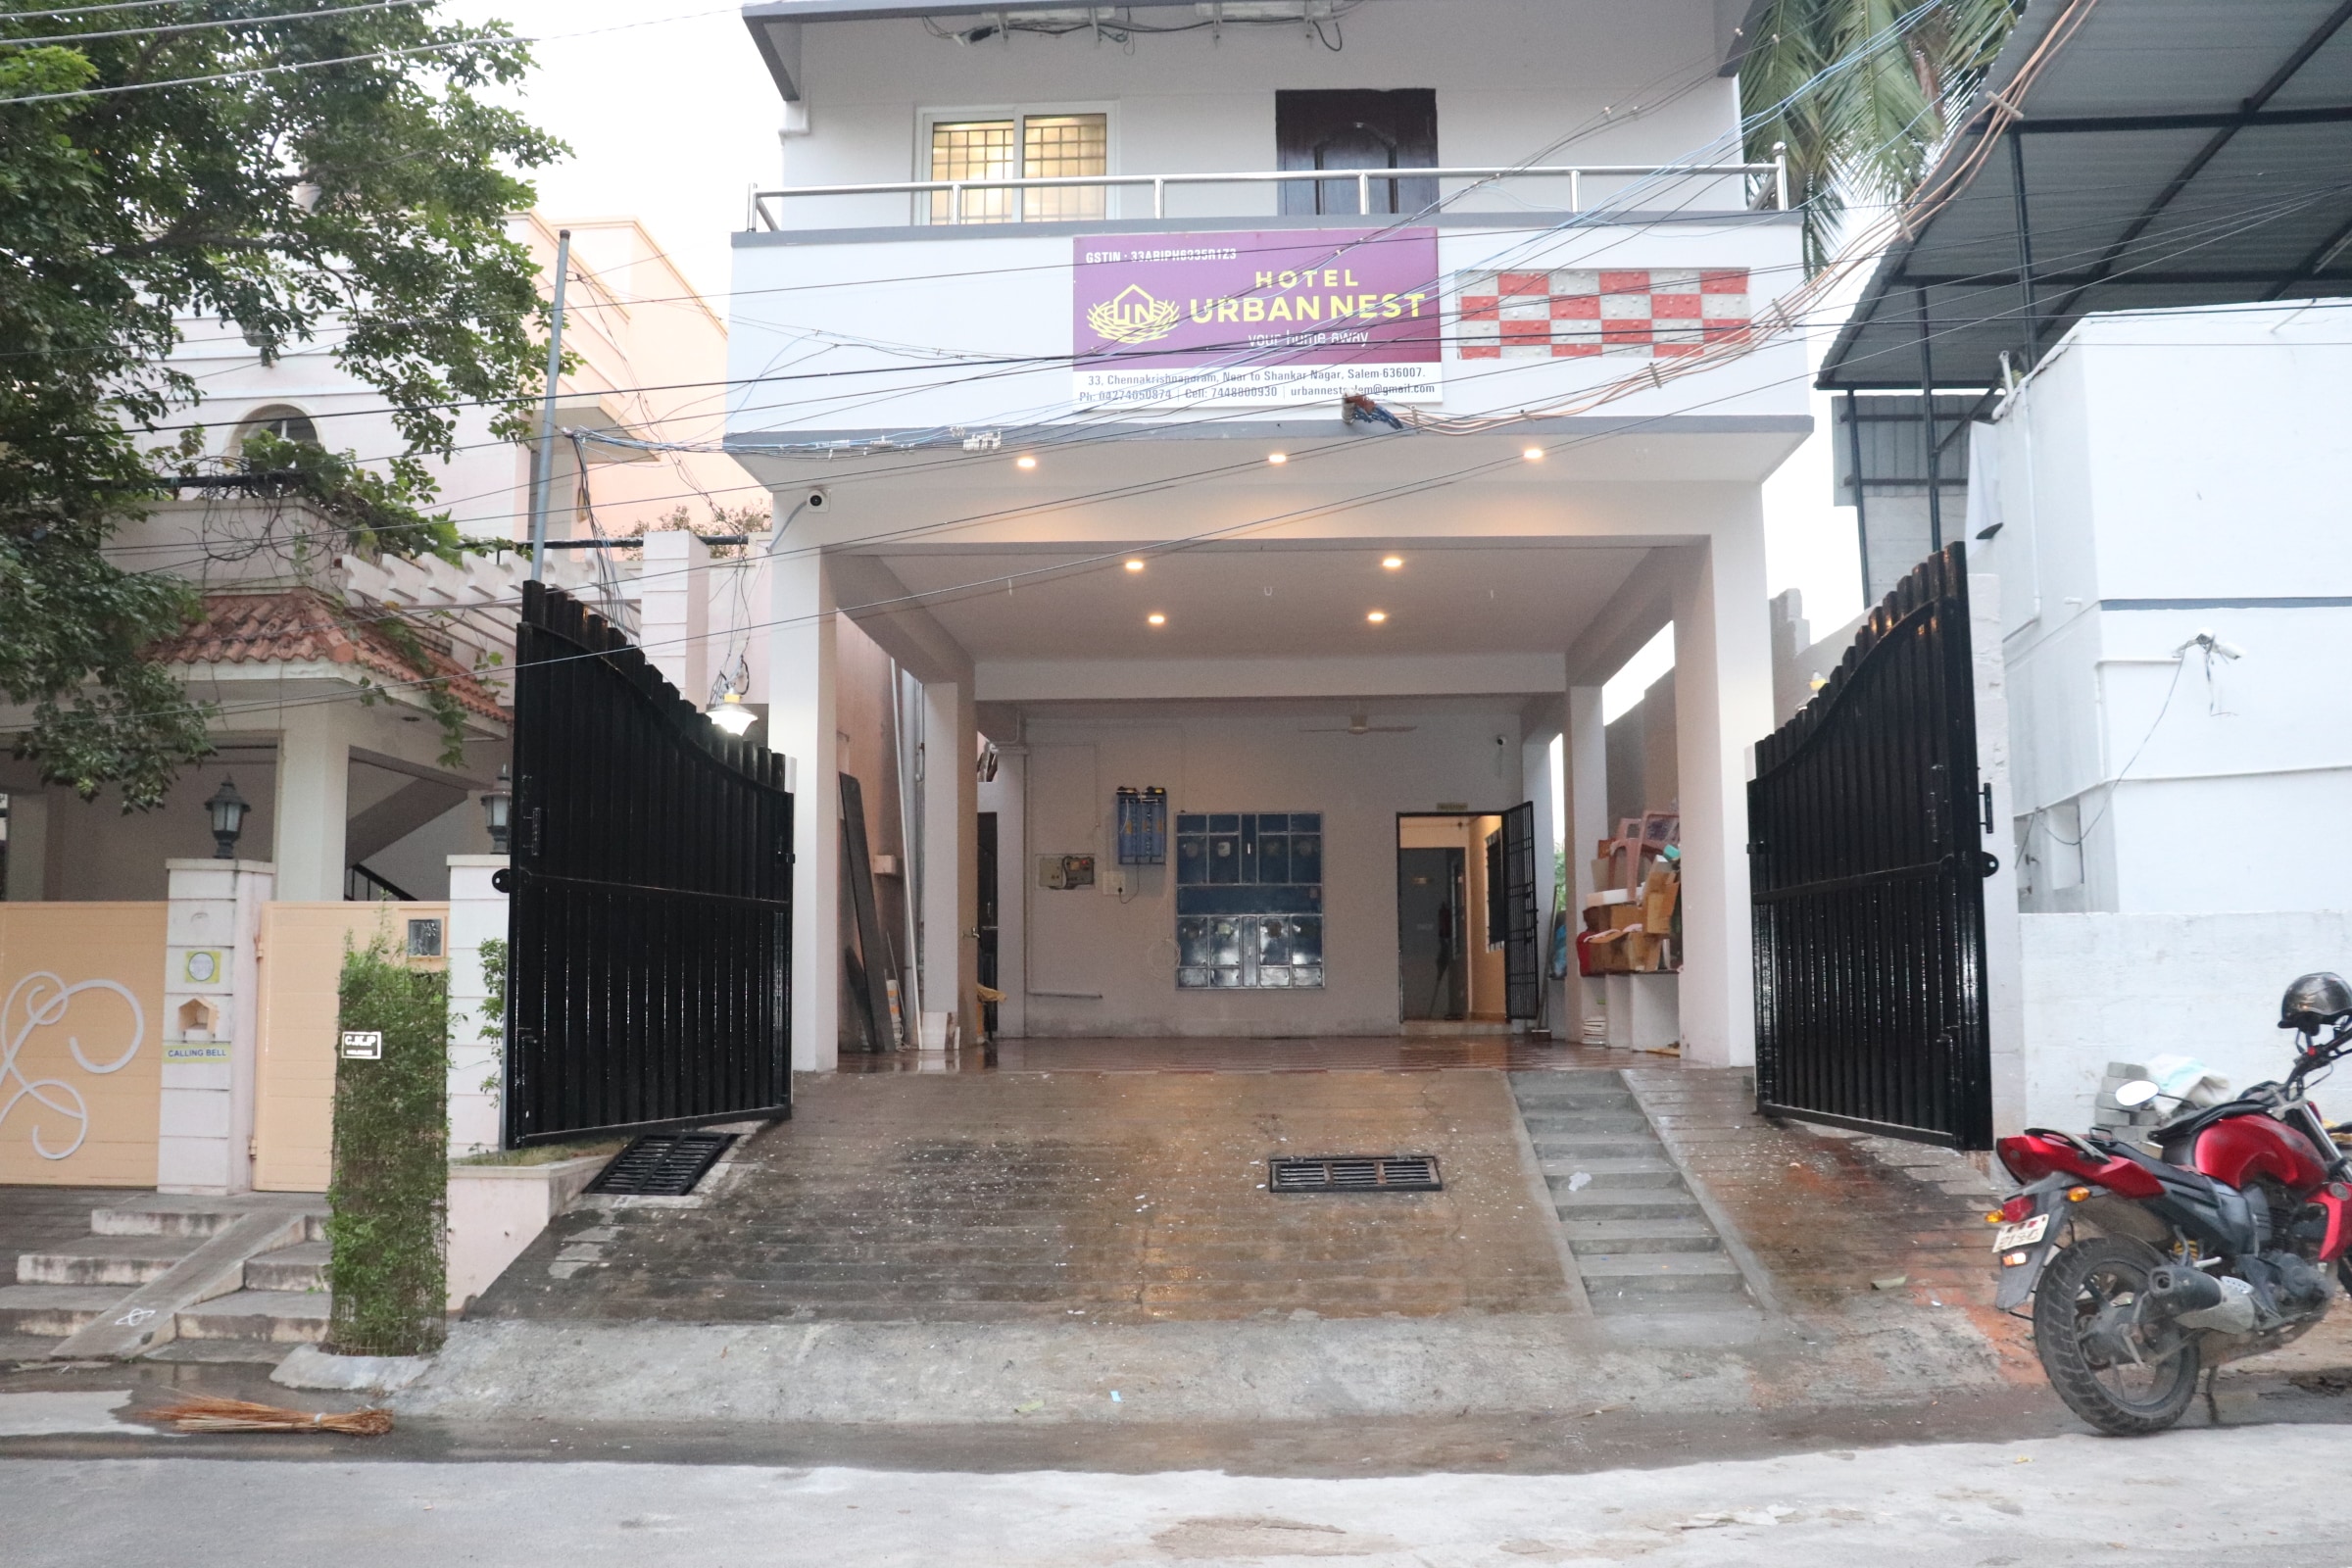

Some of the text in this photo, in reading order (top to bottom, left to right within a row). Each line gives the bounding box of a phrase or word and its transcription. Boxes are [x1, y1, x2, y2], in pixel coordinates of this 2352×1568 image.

[1086, 251, 1121, 264] GSTIN
[1255, 269, 1358, 288] HOTEL
[1190, 293, 1426, 324] URBAN NEST
[1248, 329, 1369, 348] your home away
[1088, 375, 1103, 386] 33,
[1223, 371, 1247, 382] Near
[1250, 371, 1260, 381] to
[1264, 369, 1307, 381] Shankar
[1310, 368, 1345, 382] Nagar,
[1079, 391, 1096, 402] Ph:
[1185, 387, 1207, 399] Cell:
[1291, 383, 1435, 397] urbannestlem@gmail.com
[168, 1049, 203, 1057] CALLING
